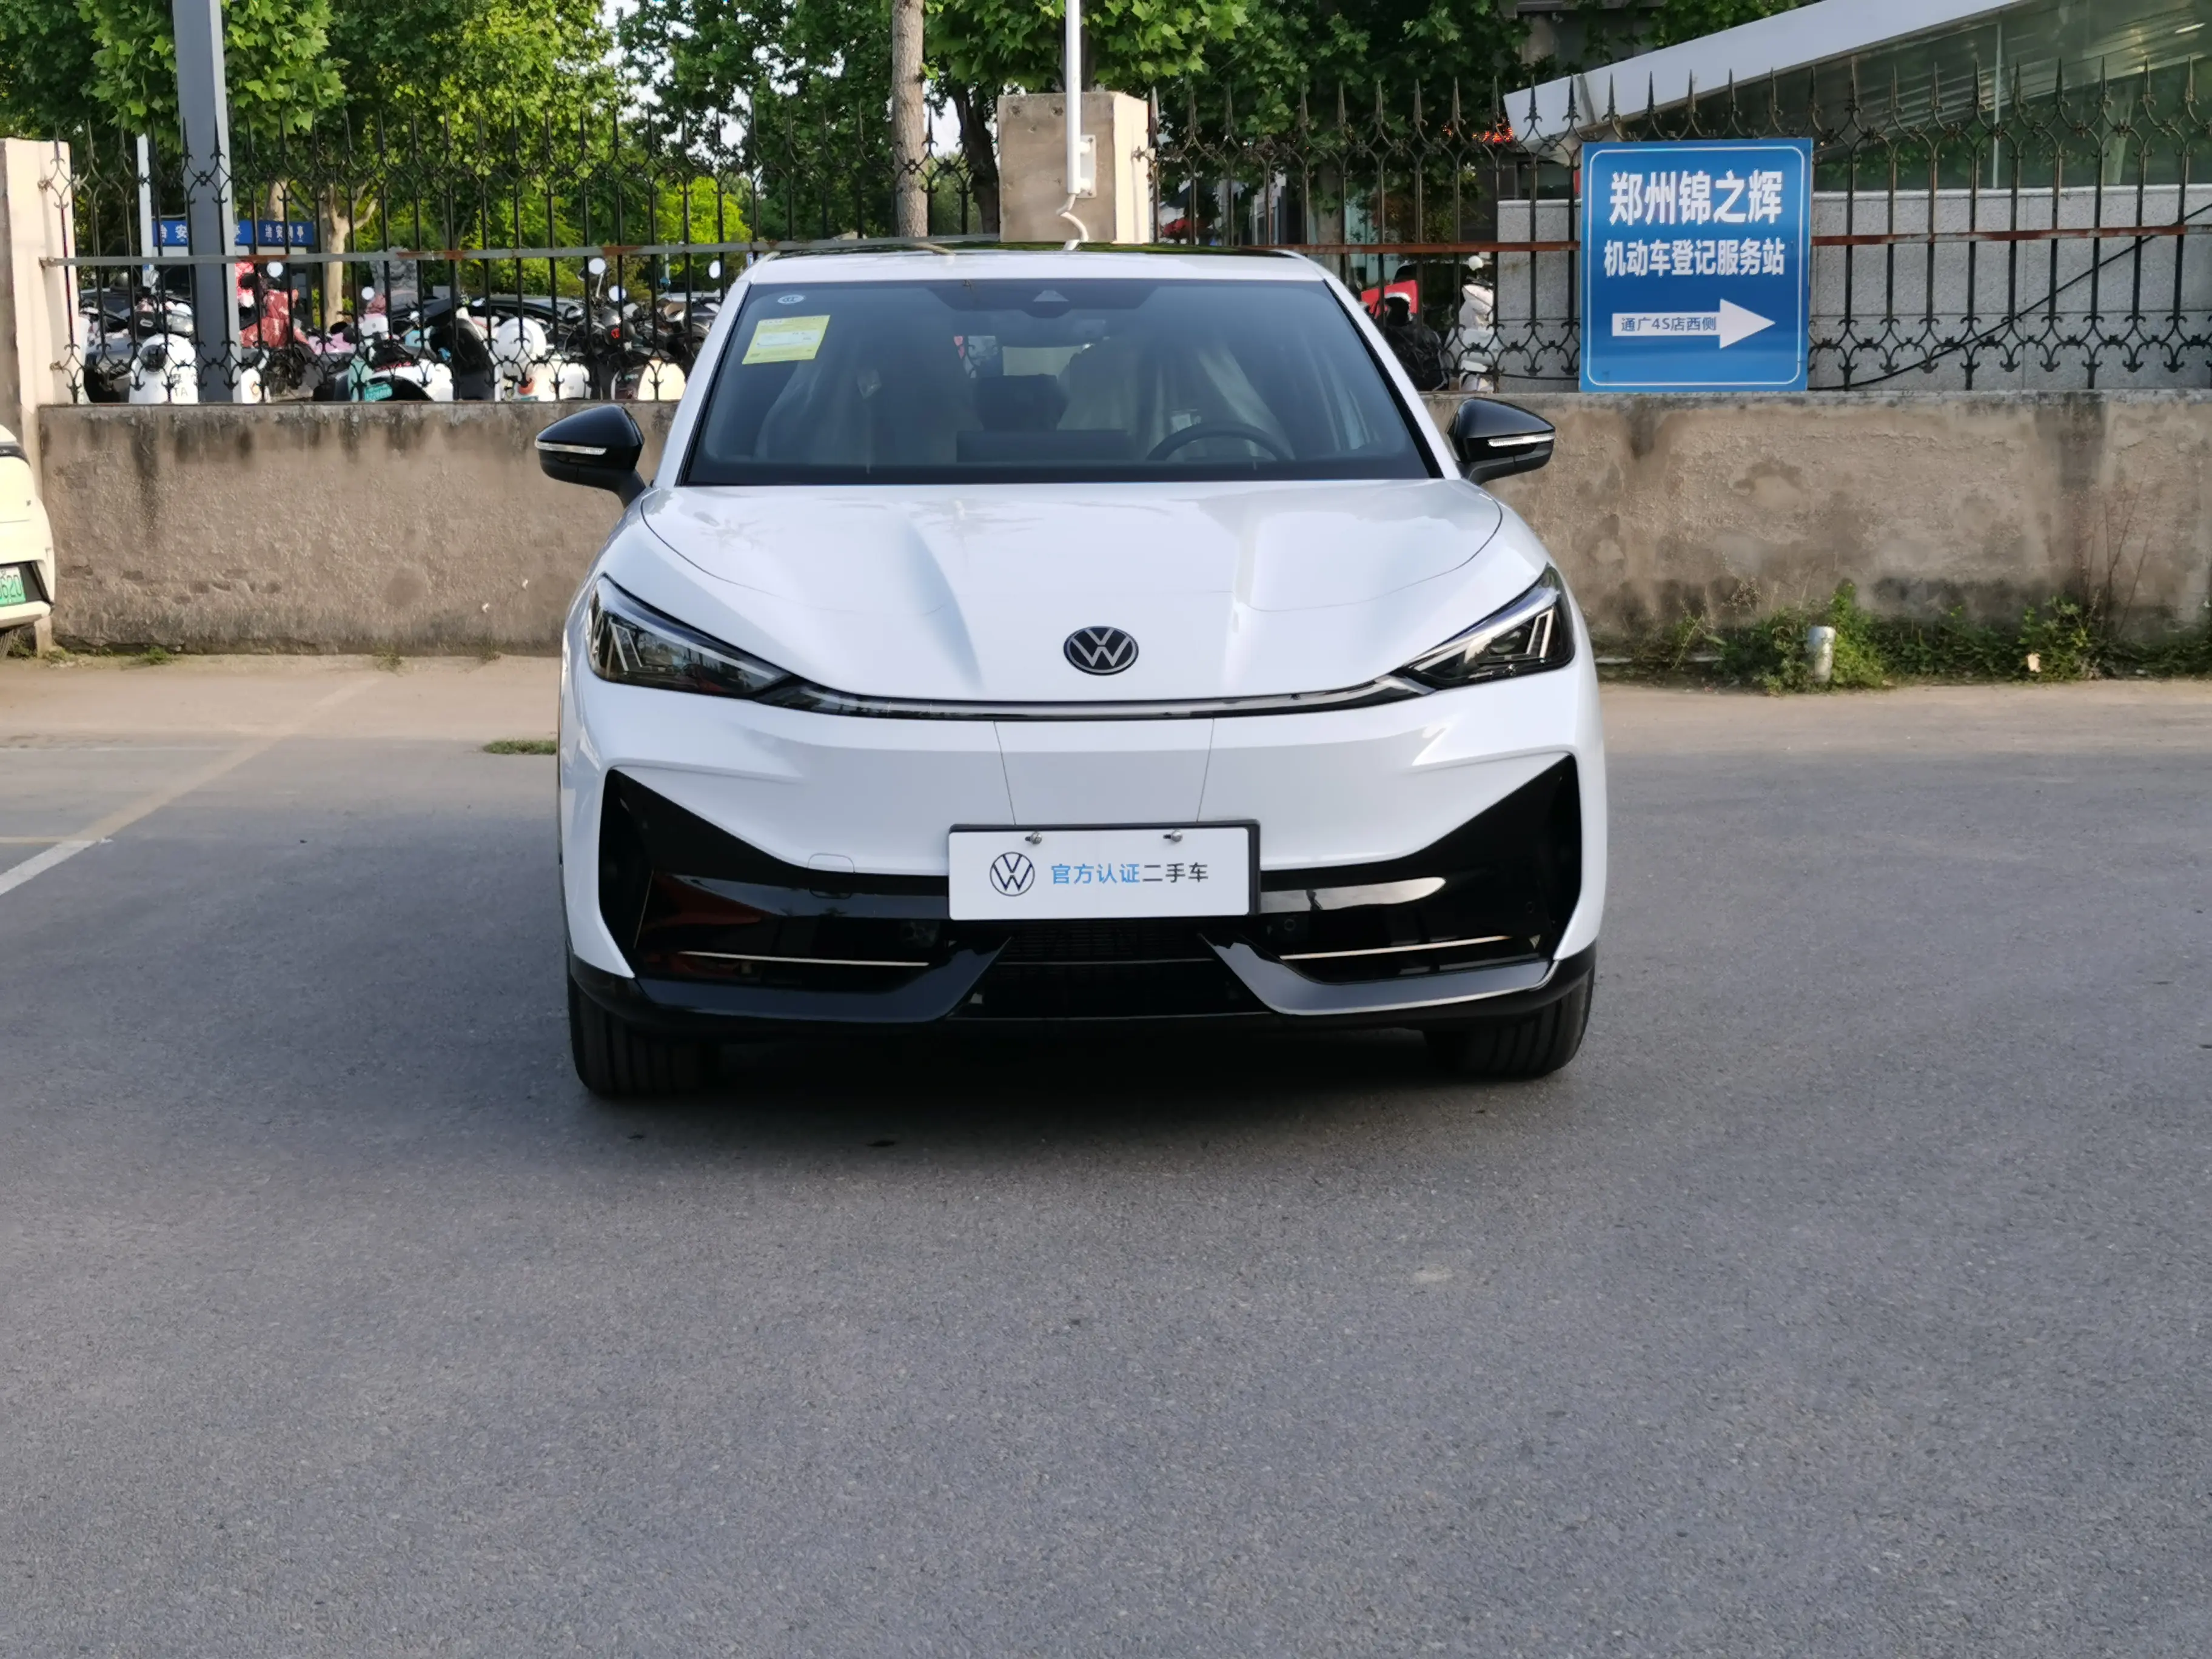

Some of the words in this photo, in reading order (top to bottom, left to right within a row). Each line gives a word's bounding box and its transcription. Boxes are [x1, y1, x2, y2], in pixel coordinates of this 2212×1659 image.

[1609, 169, 1783, 226] 郑州锦之辉
[1604, 238, 1785, 277] 机动车登记服务站
[1621, 317, 1717, 332] 通广4S店西侧
[1051, 862, 1208, 885] 官方认证二手车
